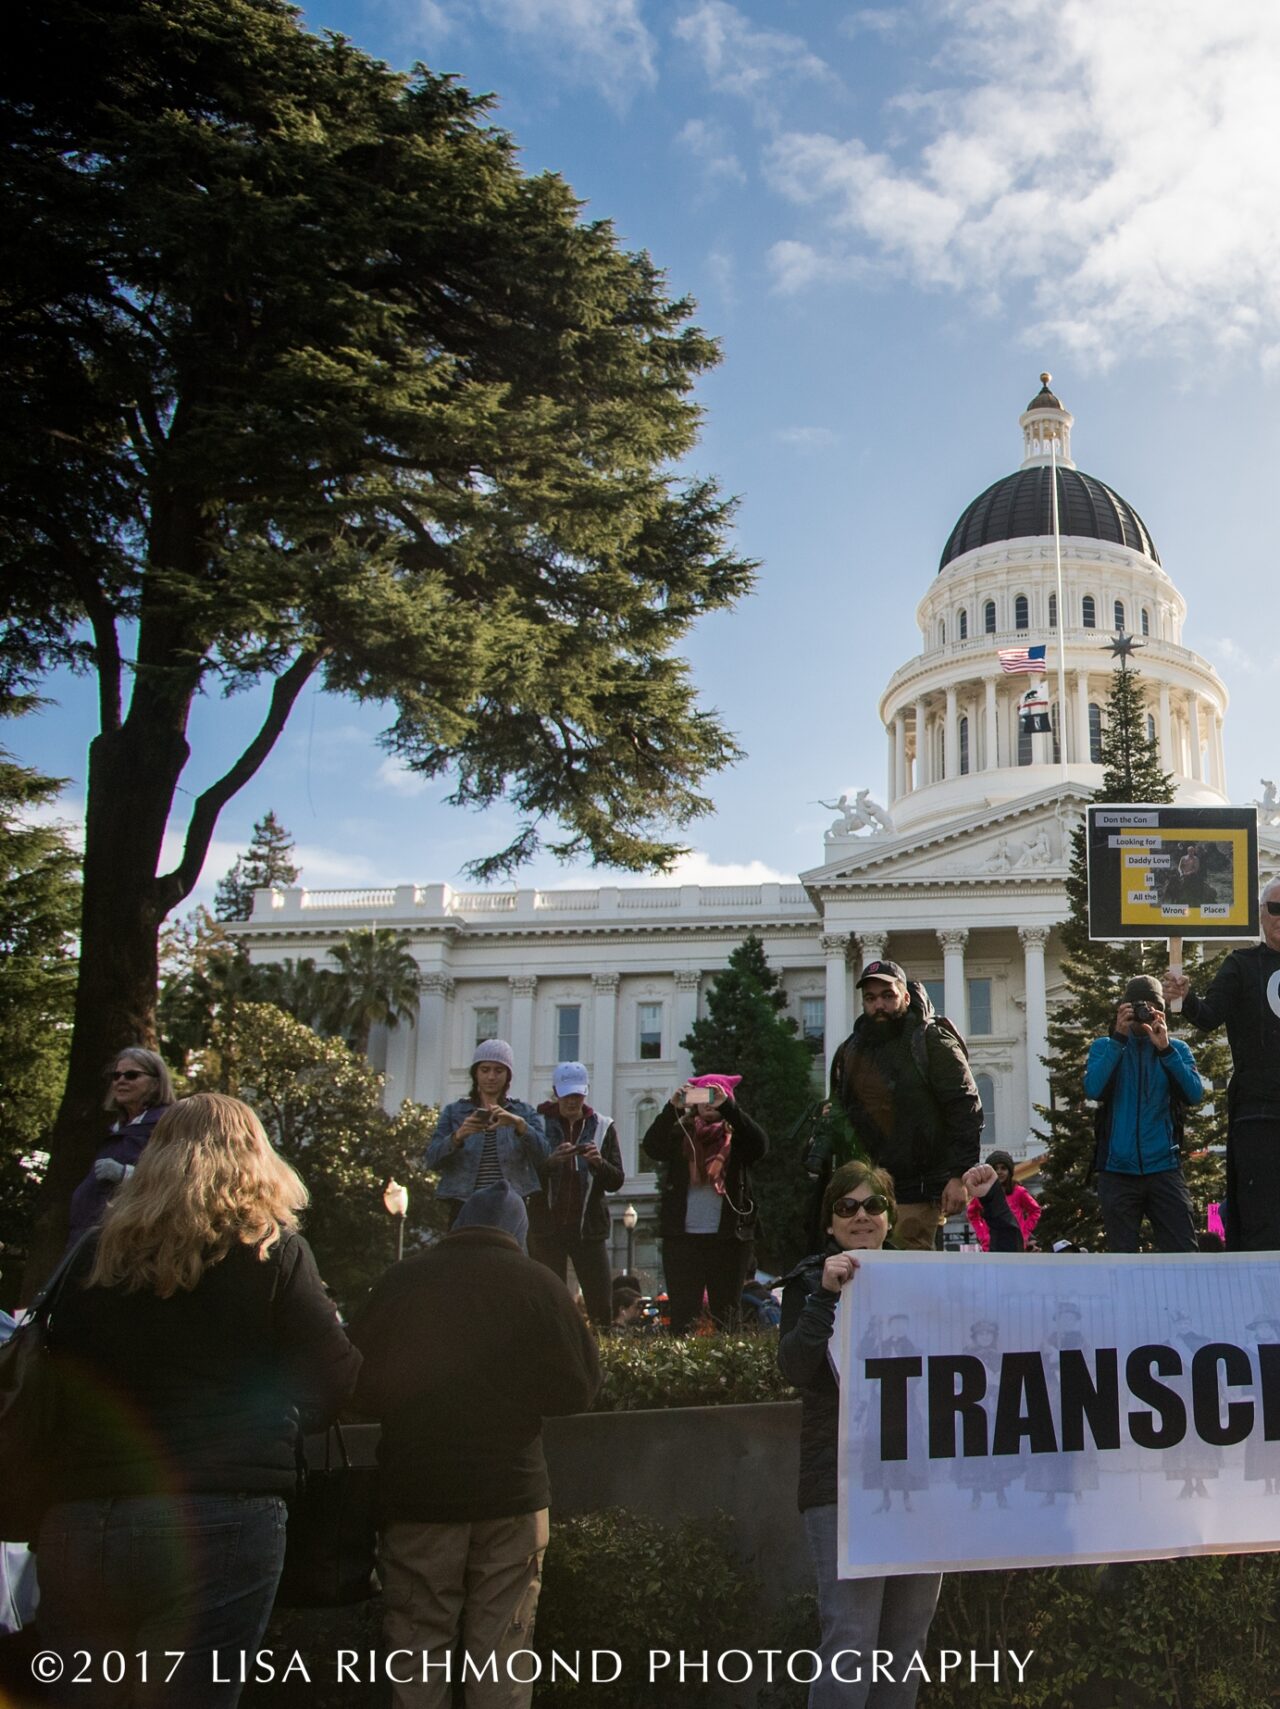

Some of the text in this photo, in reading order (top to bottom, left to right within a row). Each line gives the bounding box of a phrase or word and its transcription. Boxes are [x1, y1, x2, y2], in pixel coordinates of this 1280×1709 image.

[1116, 838, 1144, 846] Looking
[1133, 893, 1156, 901] All the
[1203, 906, 1226, 914] Places
